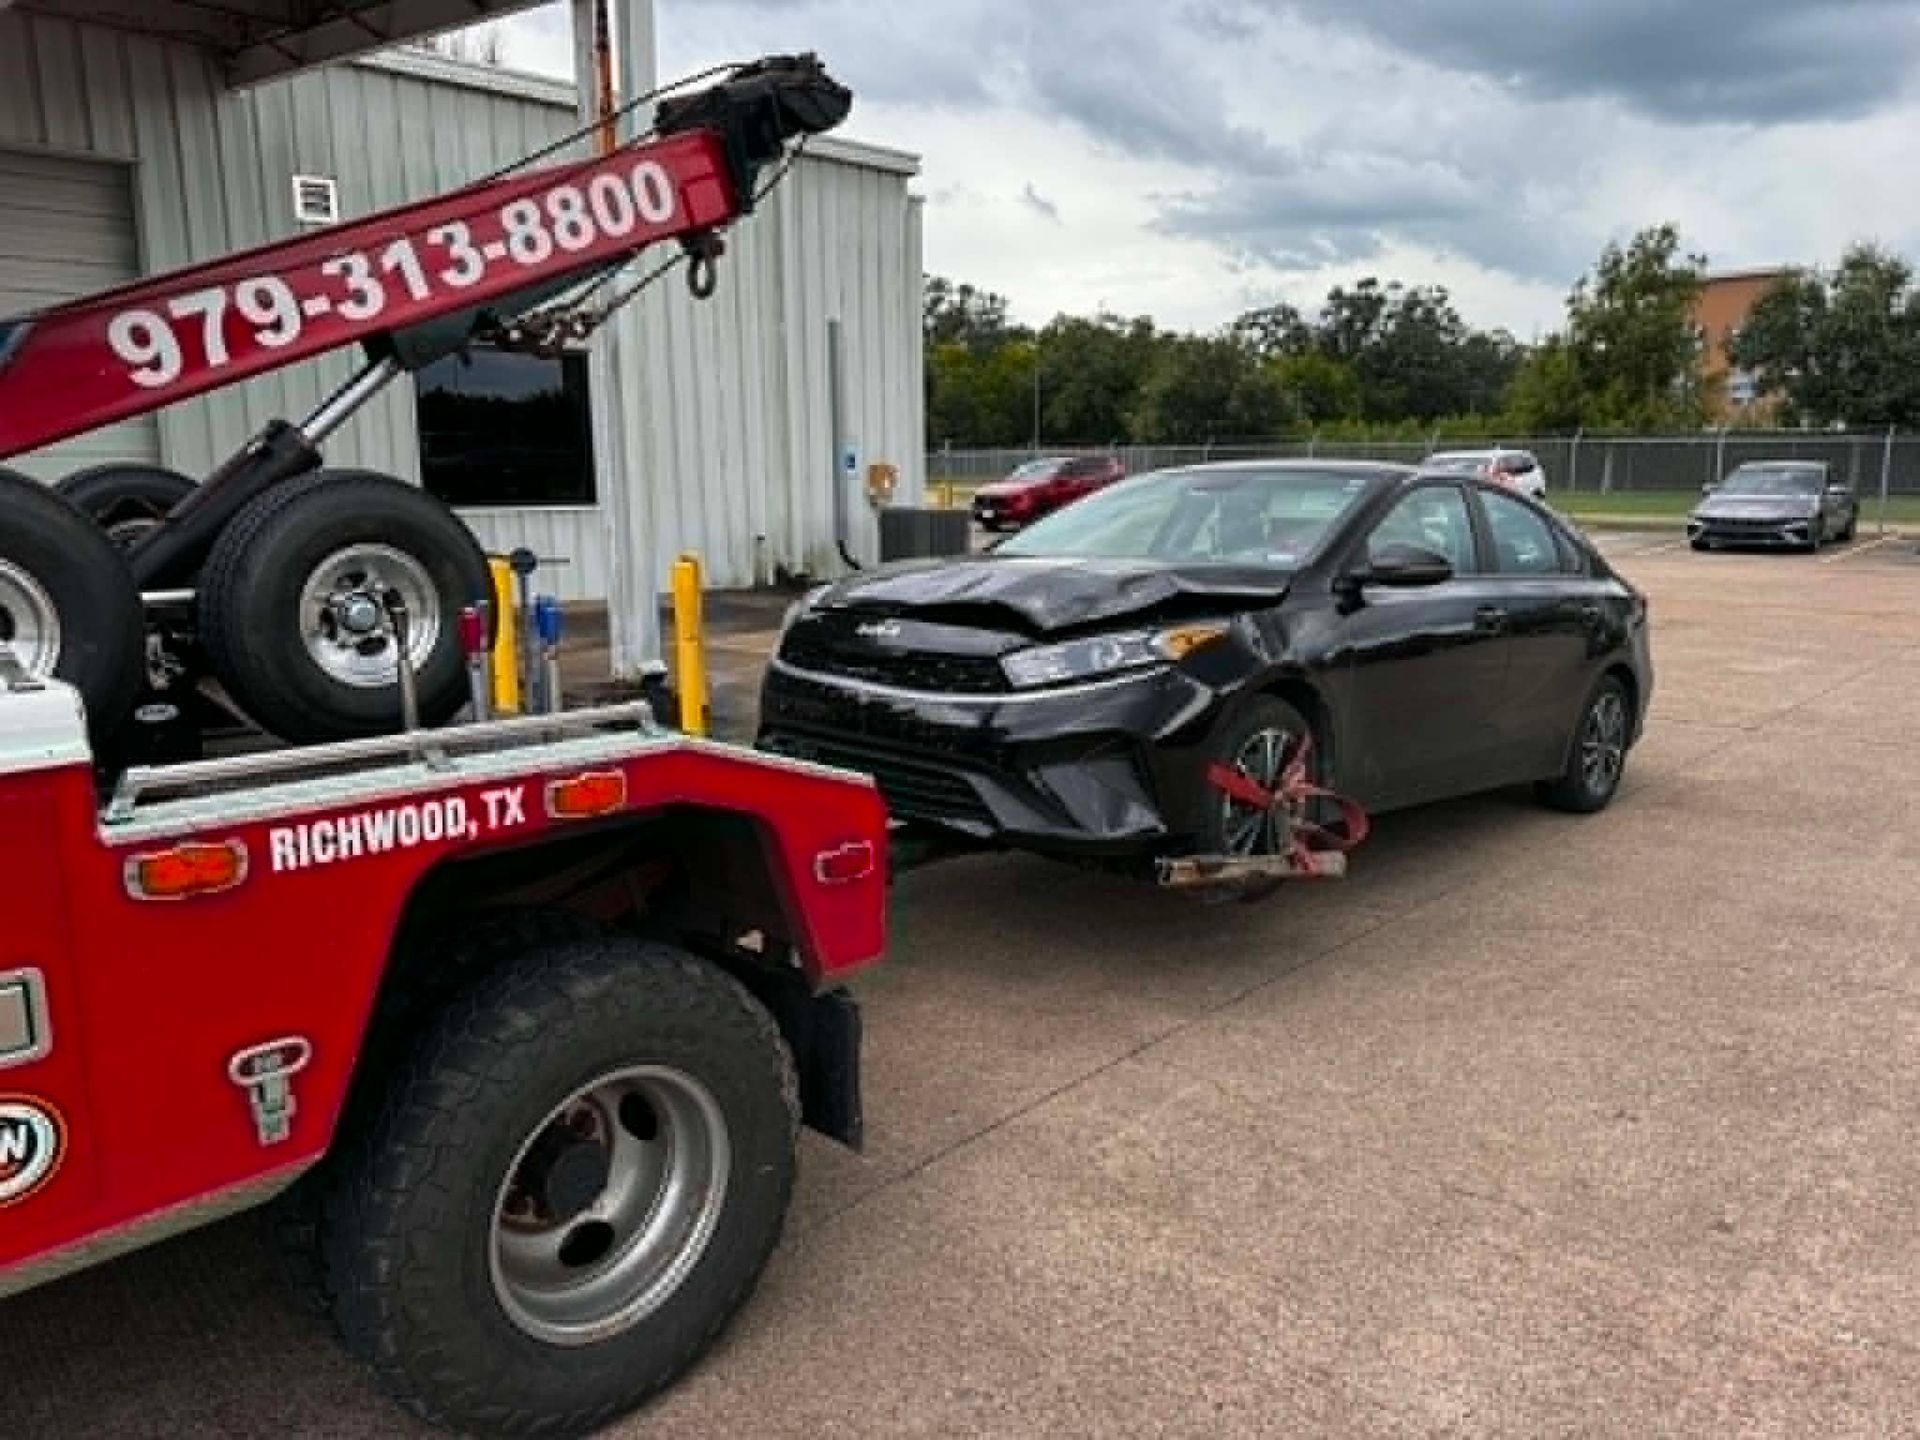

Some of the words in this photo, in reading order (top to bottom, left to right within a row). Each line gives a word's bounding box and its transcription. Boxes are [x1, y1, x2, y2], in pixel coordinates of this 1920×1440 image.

[108, 160, 676, 388] 979-313-8800
[269, 796, 478, 872] RICHWOOD,
[480, 786, 526, 830] TX
